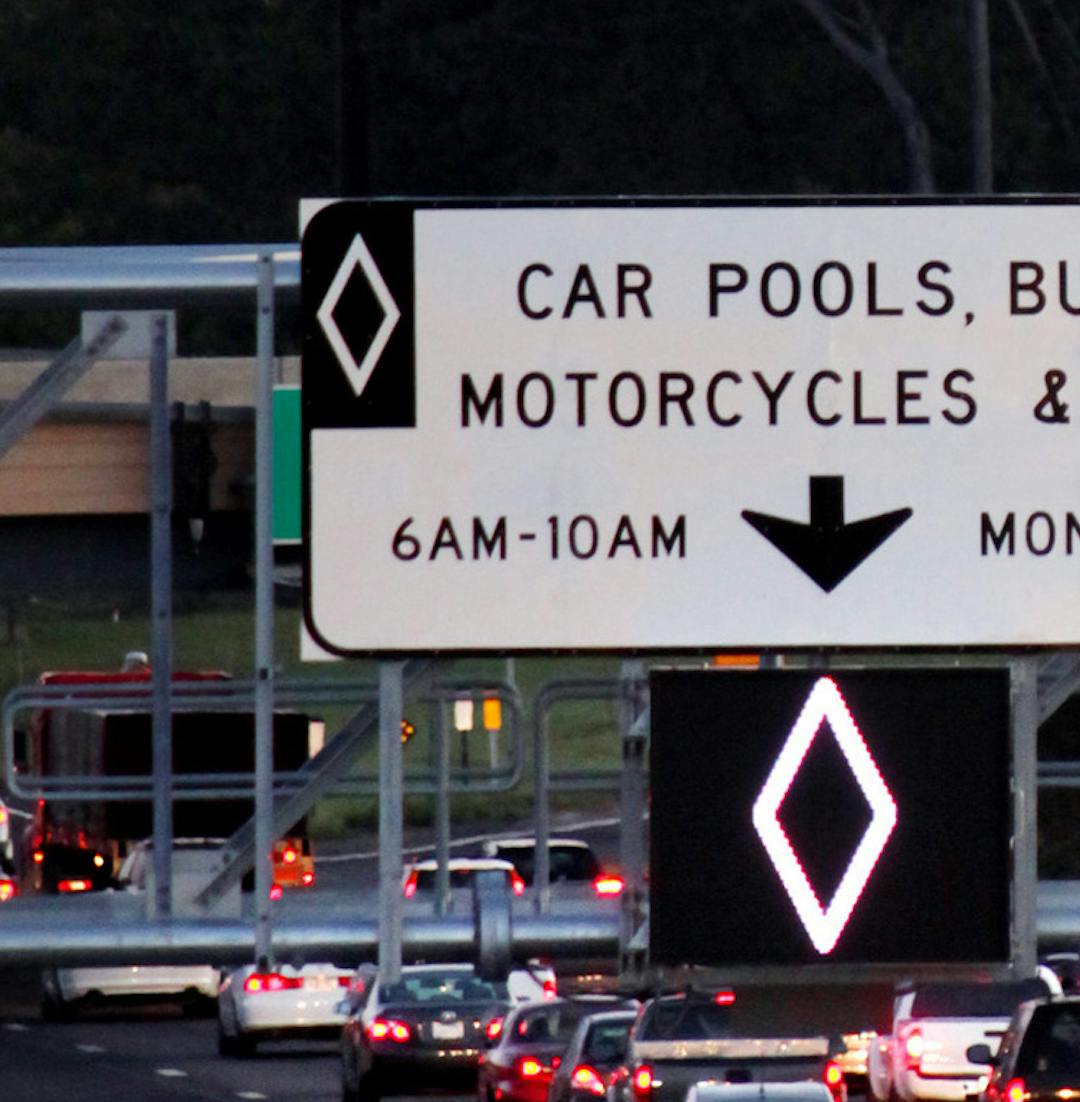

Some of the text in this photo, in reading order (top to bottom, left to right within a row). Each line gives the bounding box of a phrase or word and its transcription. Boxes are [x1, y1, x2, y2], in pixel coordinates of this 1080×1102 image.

[516, 262, 654, 321] CAR
[707, 259, 975, 327] POOLS,
[459, 368, 1071, 430] MOTORCYCLES &
[390, 513, 688, 562] 6AM-10AM
